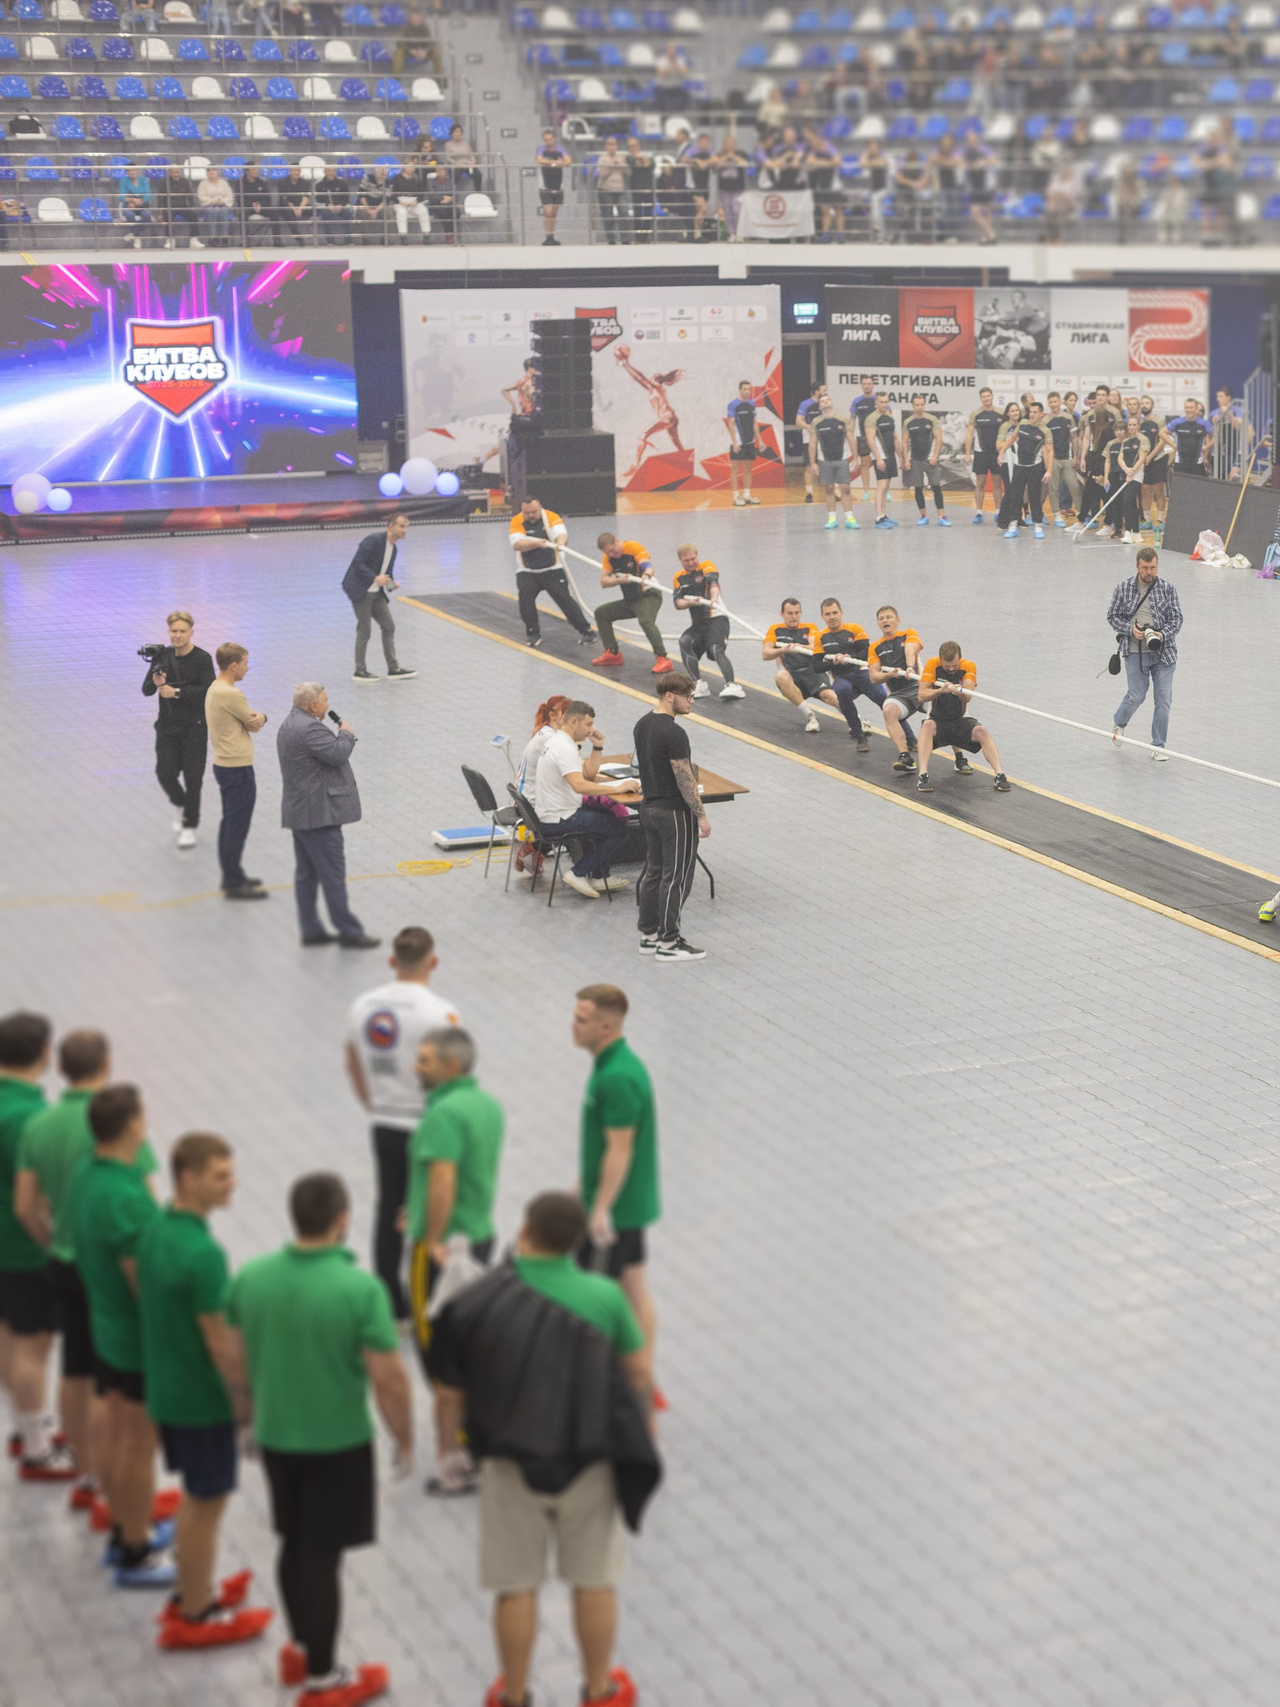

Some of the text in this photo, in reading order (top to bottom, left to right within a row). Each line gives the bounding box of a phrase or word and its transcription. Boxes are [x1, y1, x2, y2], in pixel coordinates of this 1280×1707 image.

[831, 313, 892, 326] БИЗНЕС
[917, 317, 957, 326] БИТВА
[842, 329, 881, 341] ЛИГА
[914, 325, 960, 334] КЛУБОВ
[1070, 332, 1110, 344] ЛИГА
[132, 346, 217, 364] БИТВА
[126, 362, 225, 382] КЛУБОВ
